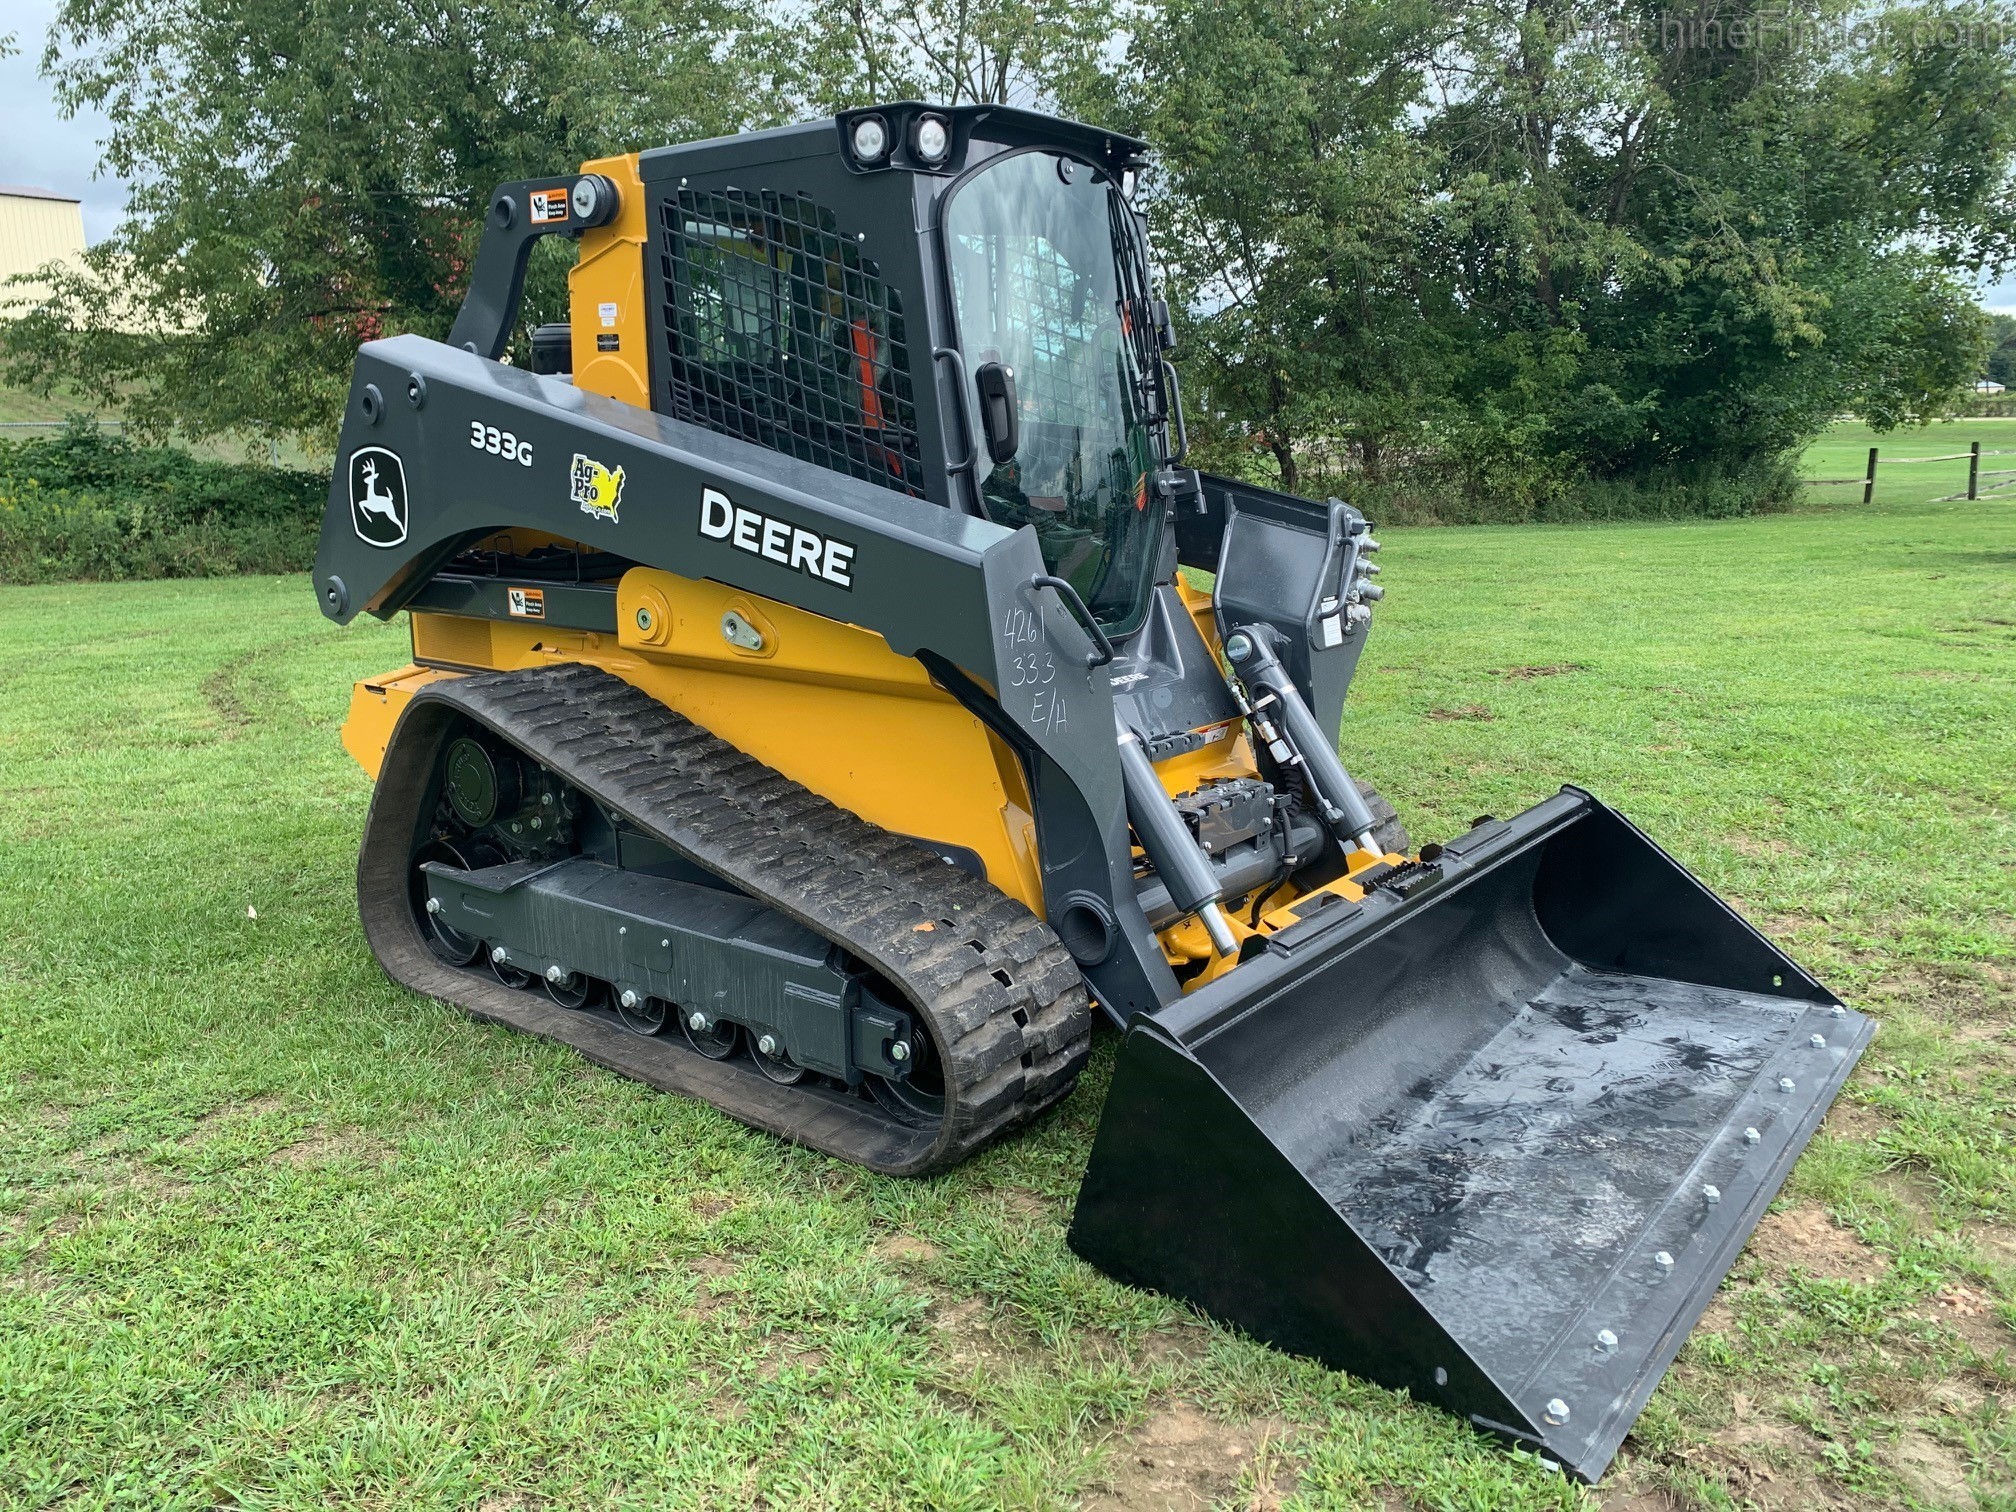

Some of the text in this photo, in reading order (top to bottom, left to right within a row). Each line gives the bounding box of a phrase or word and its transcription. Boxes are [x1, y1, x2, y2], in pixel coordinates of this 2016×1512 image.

[470, 420, 533, 467] 333G
[574, 458, 599, 484] Ag-
[574, 477, 599, 500] Pro
[700, 487, 855, 588] DEERE
[1003, 605, 1046, 650] 4261
[1011, 652, 1057, 687] 333
[1030, 687, 1069, 737] E/H
